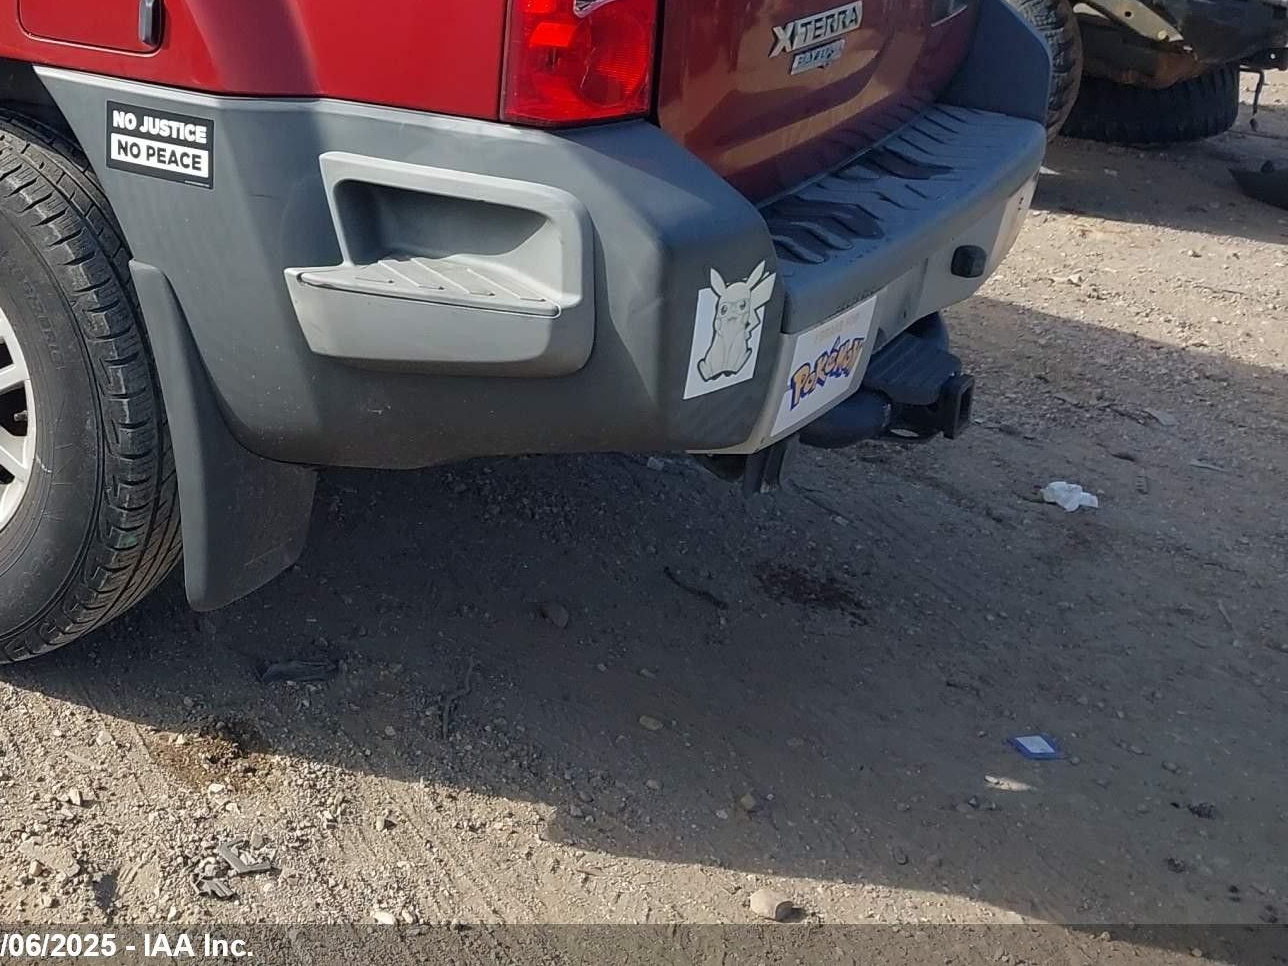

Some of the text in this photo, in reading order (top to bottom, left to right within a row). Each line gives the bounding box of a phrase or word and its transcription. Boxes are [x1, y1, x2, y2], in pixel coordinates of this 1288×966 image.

[768, 4, 859, 59] XTERRA
[113, 110, 207, 144] NO JUSTICE
[117, 139, 202, 171] NO PEACE
